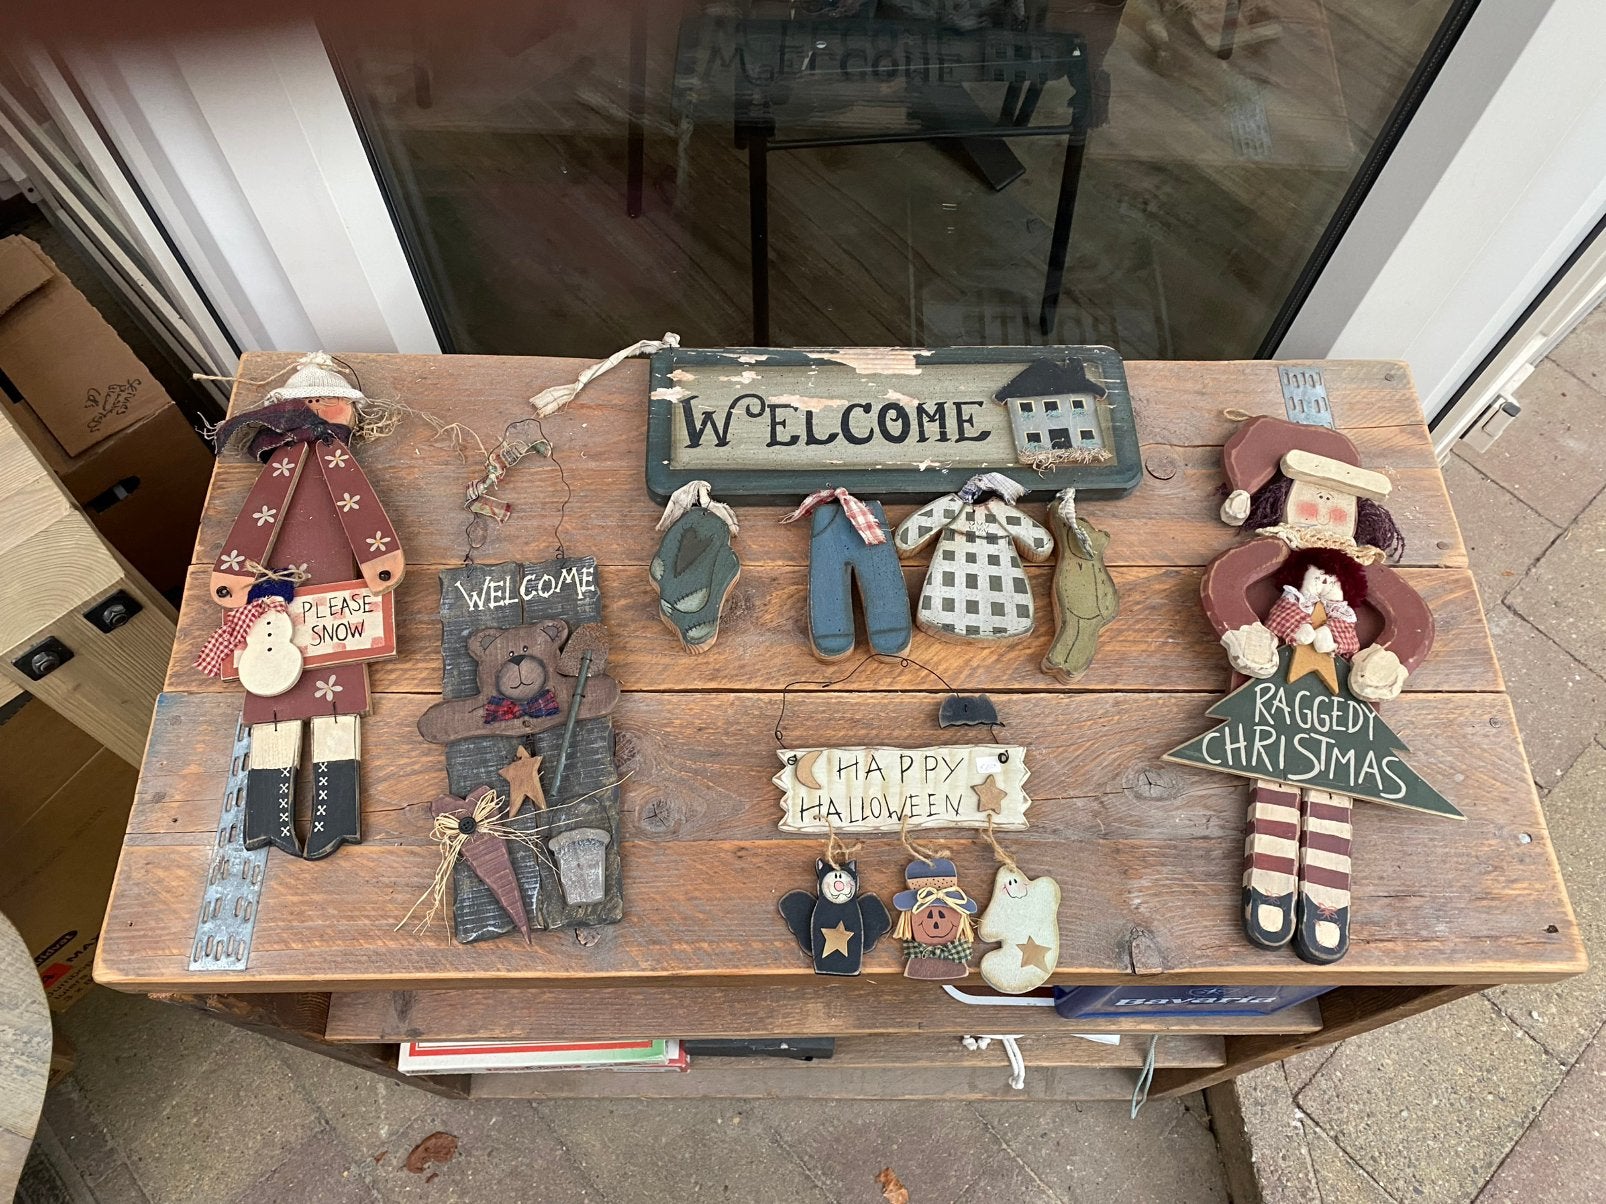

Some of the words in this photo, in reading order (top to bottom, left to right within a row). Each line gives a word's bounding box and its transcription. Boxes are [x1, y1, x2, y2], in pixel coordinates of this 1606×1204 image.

[680, 393, 992, 450] WELCOME
[454, 566, 596, 612] WELCOME
[302, 593, 375, 625] PLEASE
[309, 618, 366, 647] SNOW
[1254, 682, 1377, 741] RAGGEDY
[836, 753, 965, 784] HAPPY
[1202, 722, 1408, 800] CHRISTMAS
[799, 792, 964, 824] HALLOWEEN
[66, 934, 99, 962] MA
[1114, 995, 1278, 1007] Bavaria
